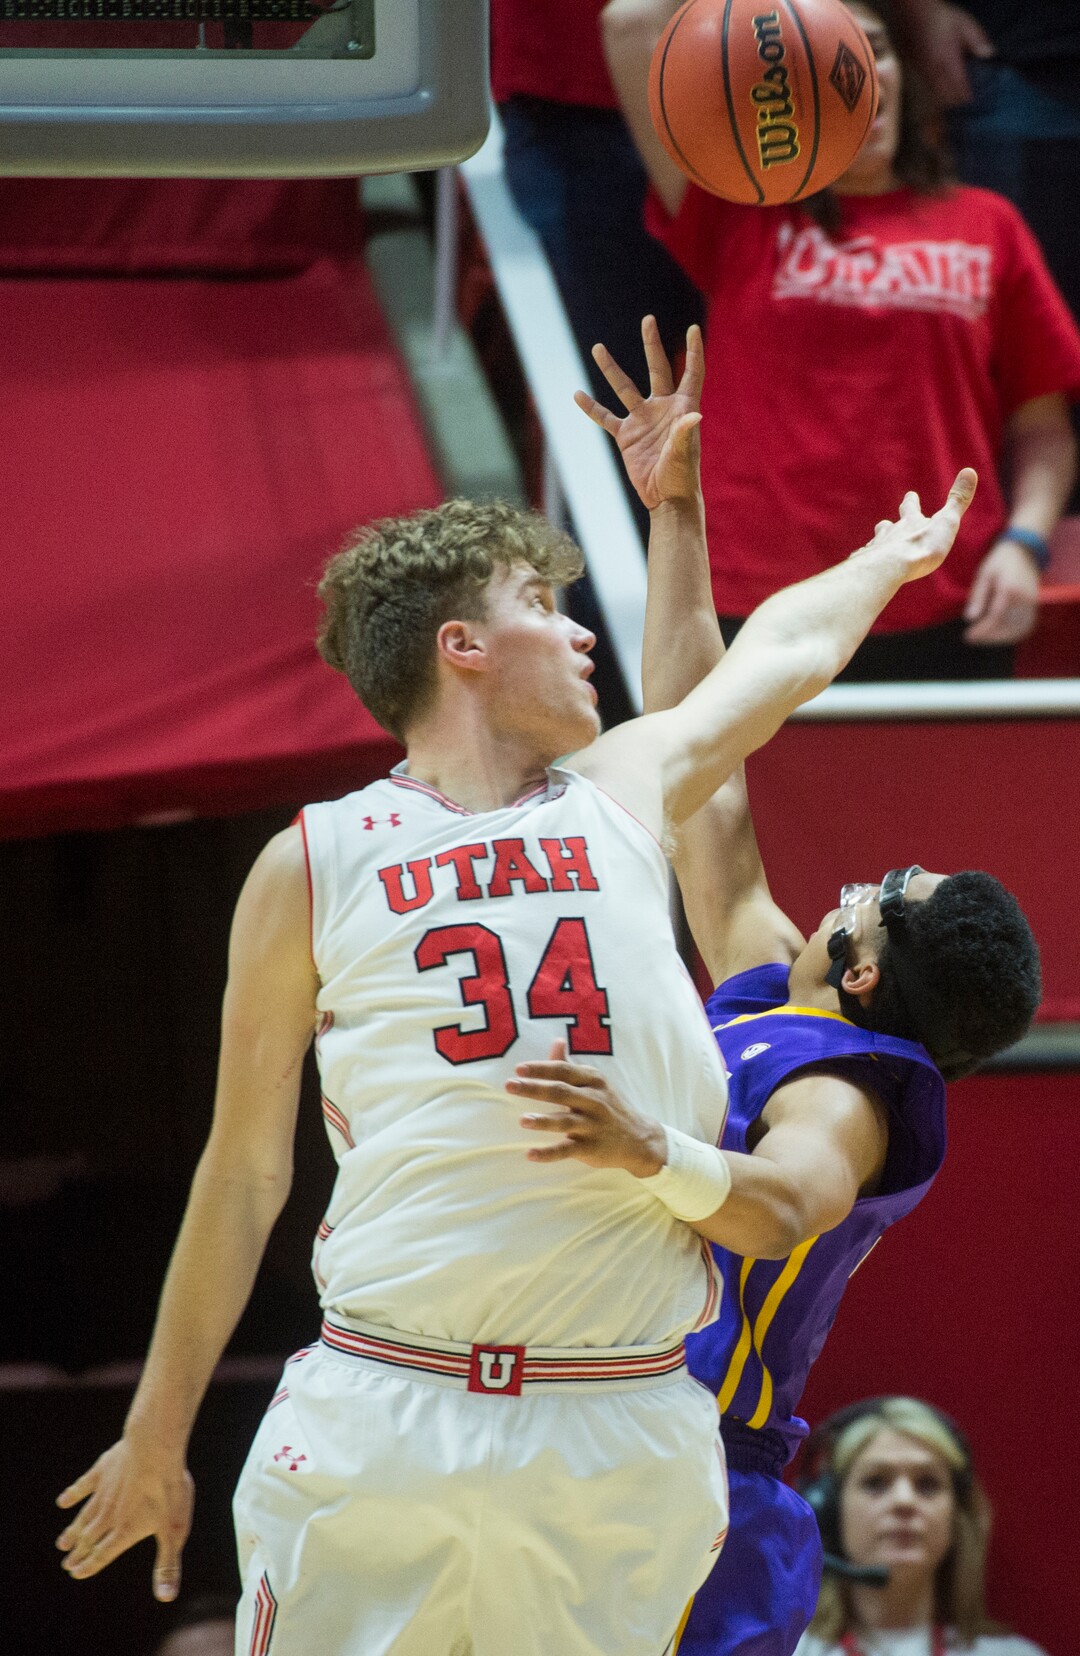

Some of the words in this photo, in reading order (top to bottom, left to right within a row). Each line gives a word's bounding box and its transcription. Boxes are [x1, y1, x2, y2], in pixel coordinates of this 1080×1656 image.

[752, 10, 801, 171] Wilson
[378, 836, 600, 915] UTAH
[414, 916, 613, 1066] 34
[478, 1350, 518, 1390] U
